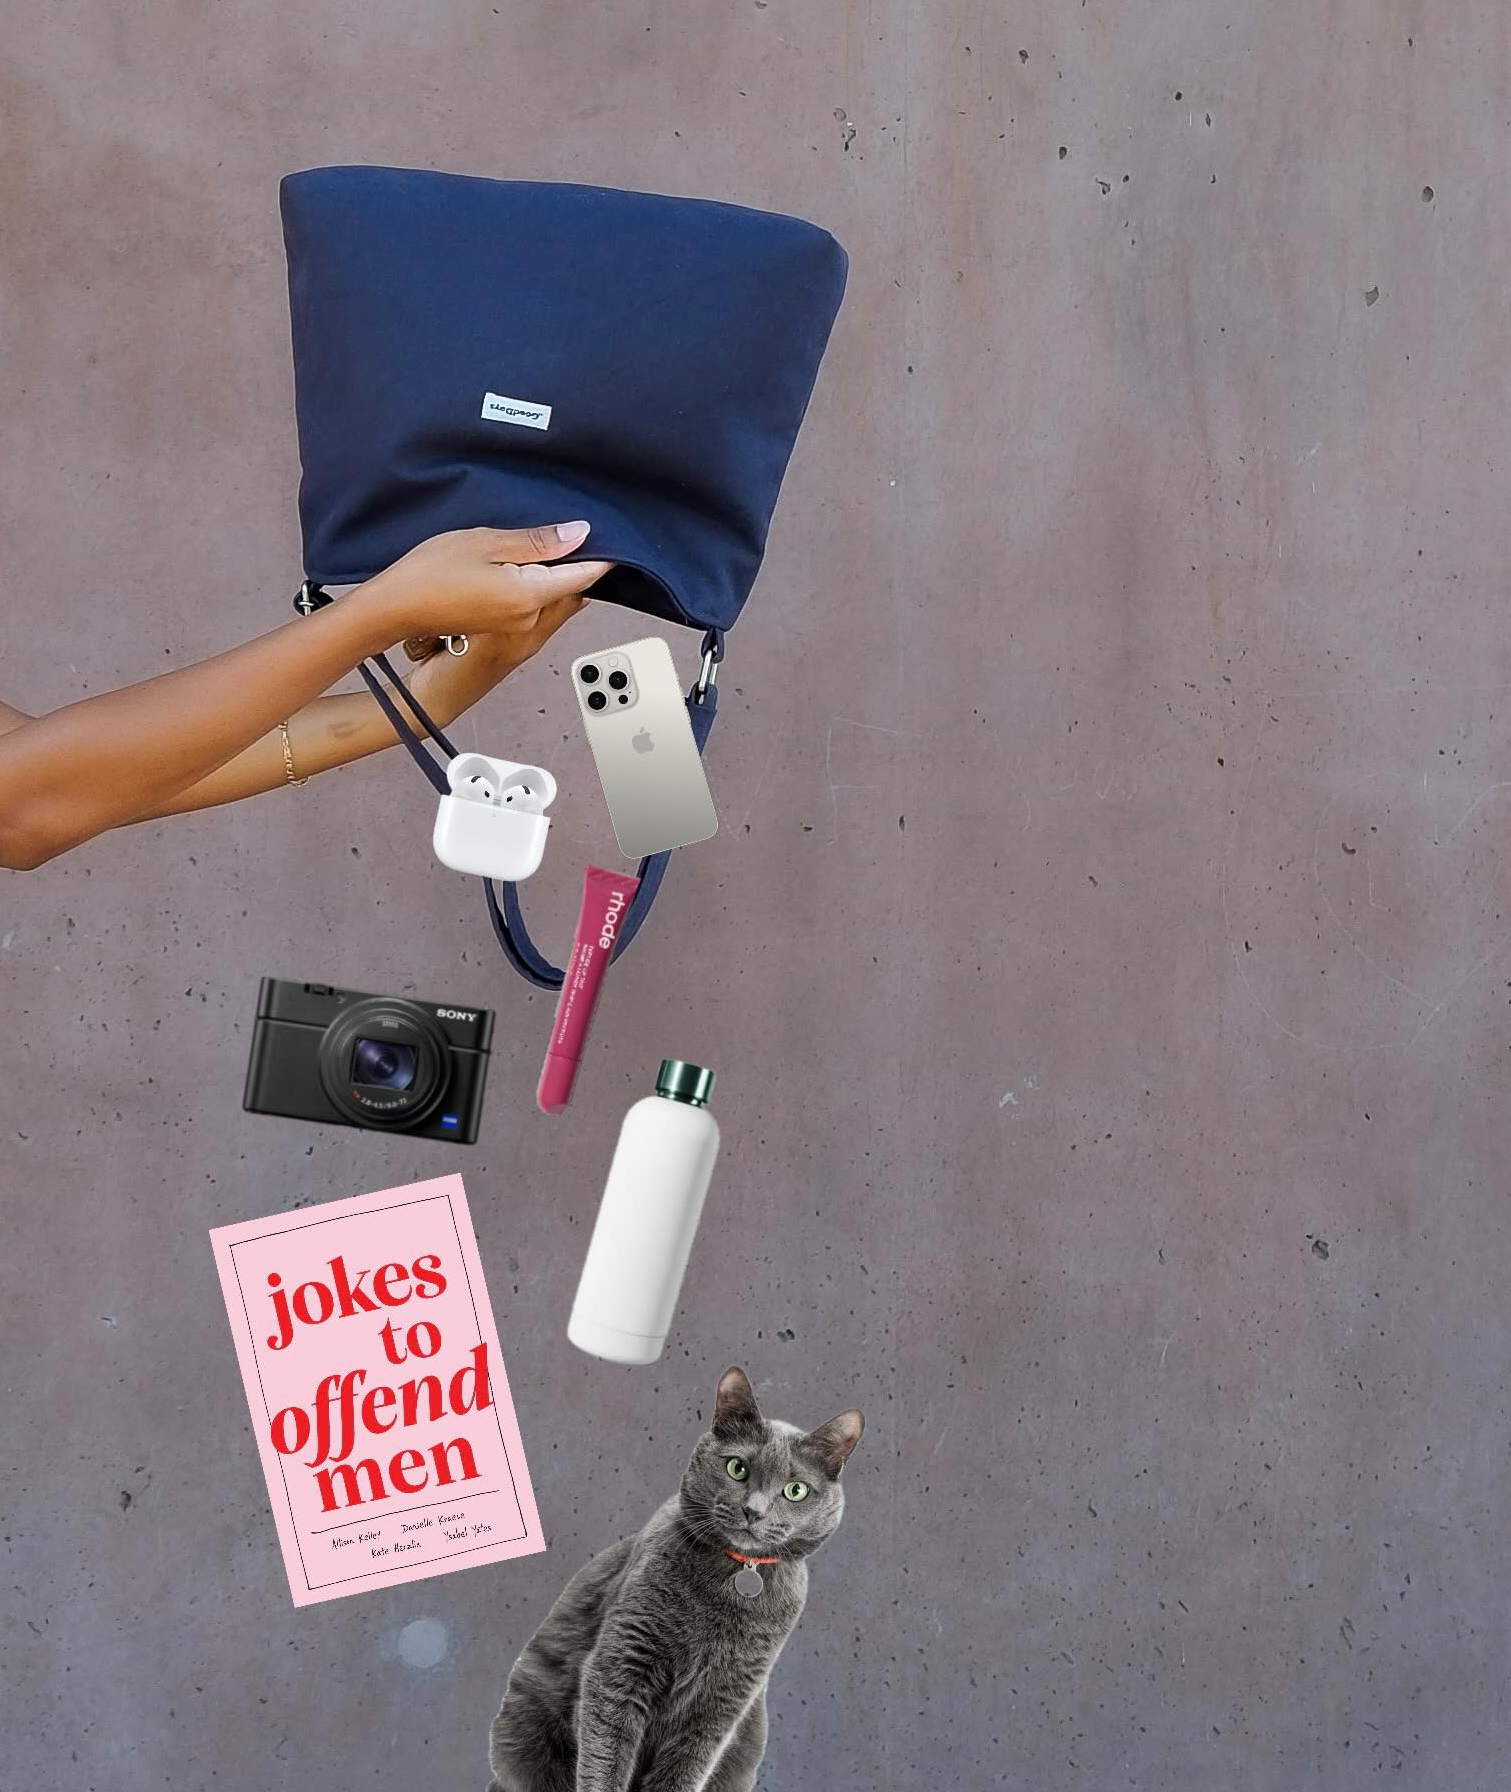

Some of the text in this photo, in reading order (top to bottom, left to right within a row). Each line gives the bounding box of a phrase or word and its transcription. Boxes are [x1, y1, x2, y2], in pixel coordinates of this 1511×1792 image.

[599, 891, 626, 950] rhode
[436, 1008, 478, 1023] SONY
[266, 1255, 448, 1351] jokes
[378, 1318, 442, 1365] to
[270, 1343, 495, 1469] offend
[312, 1437, 481, 1513] men
[400, 1518, 433, 1534] Danielle
[371, 1548, 389, 1559] Kate
